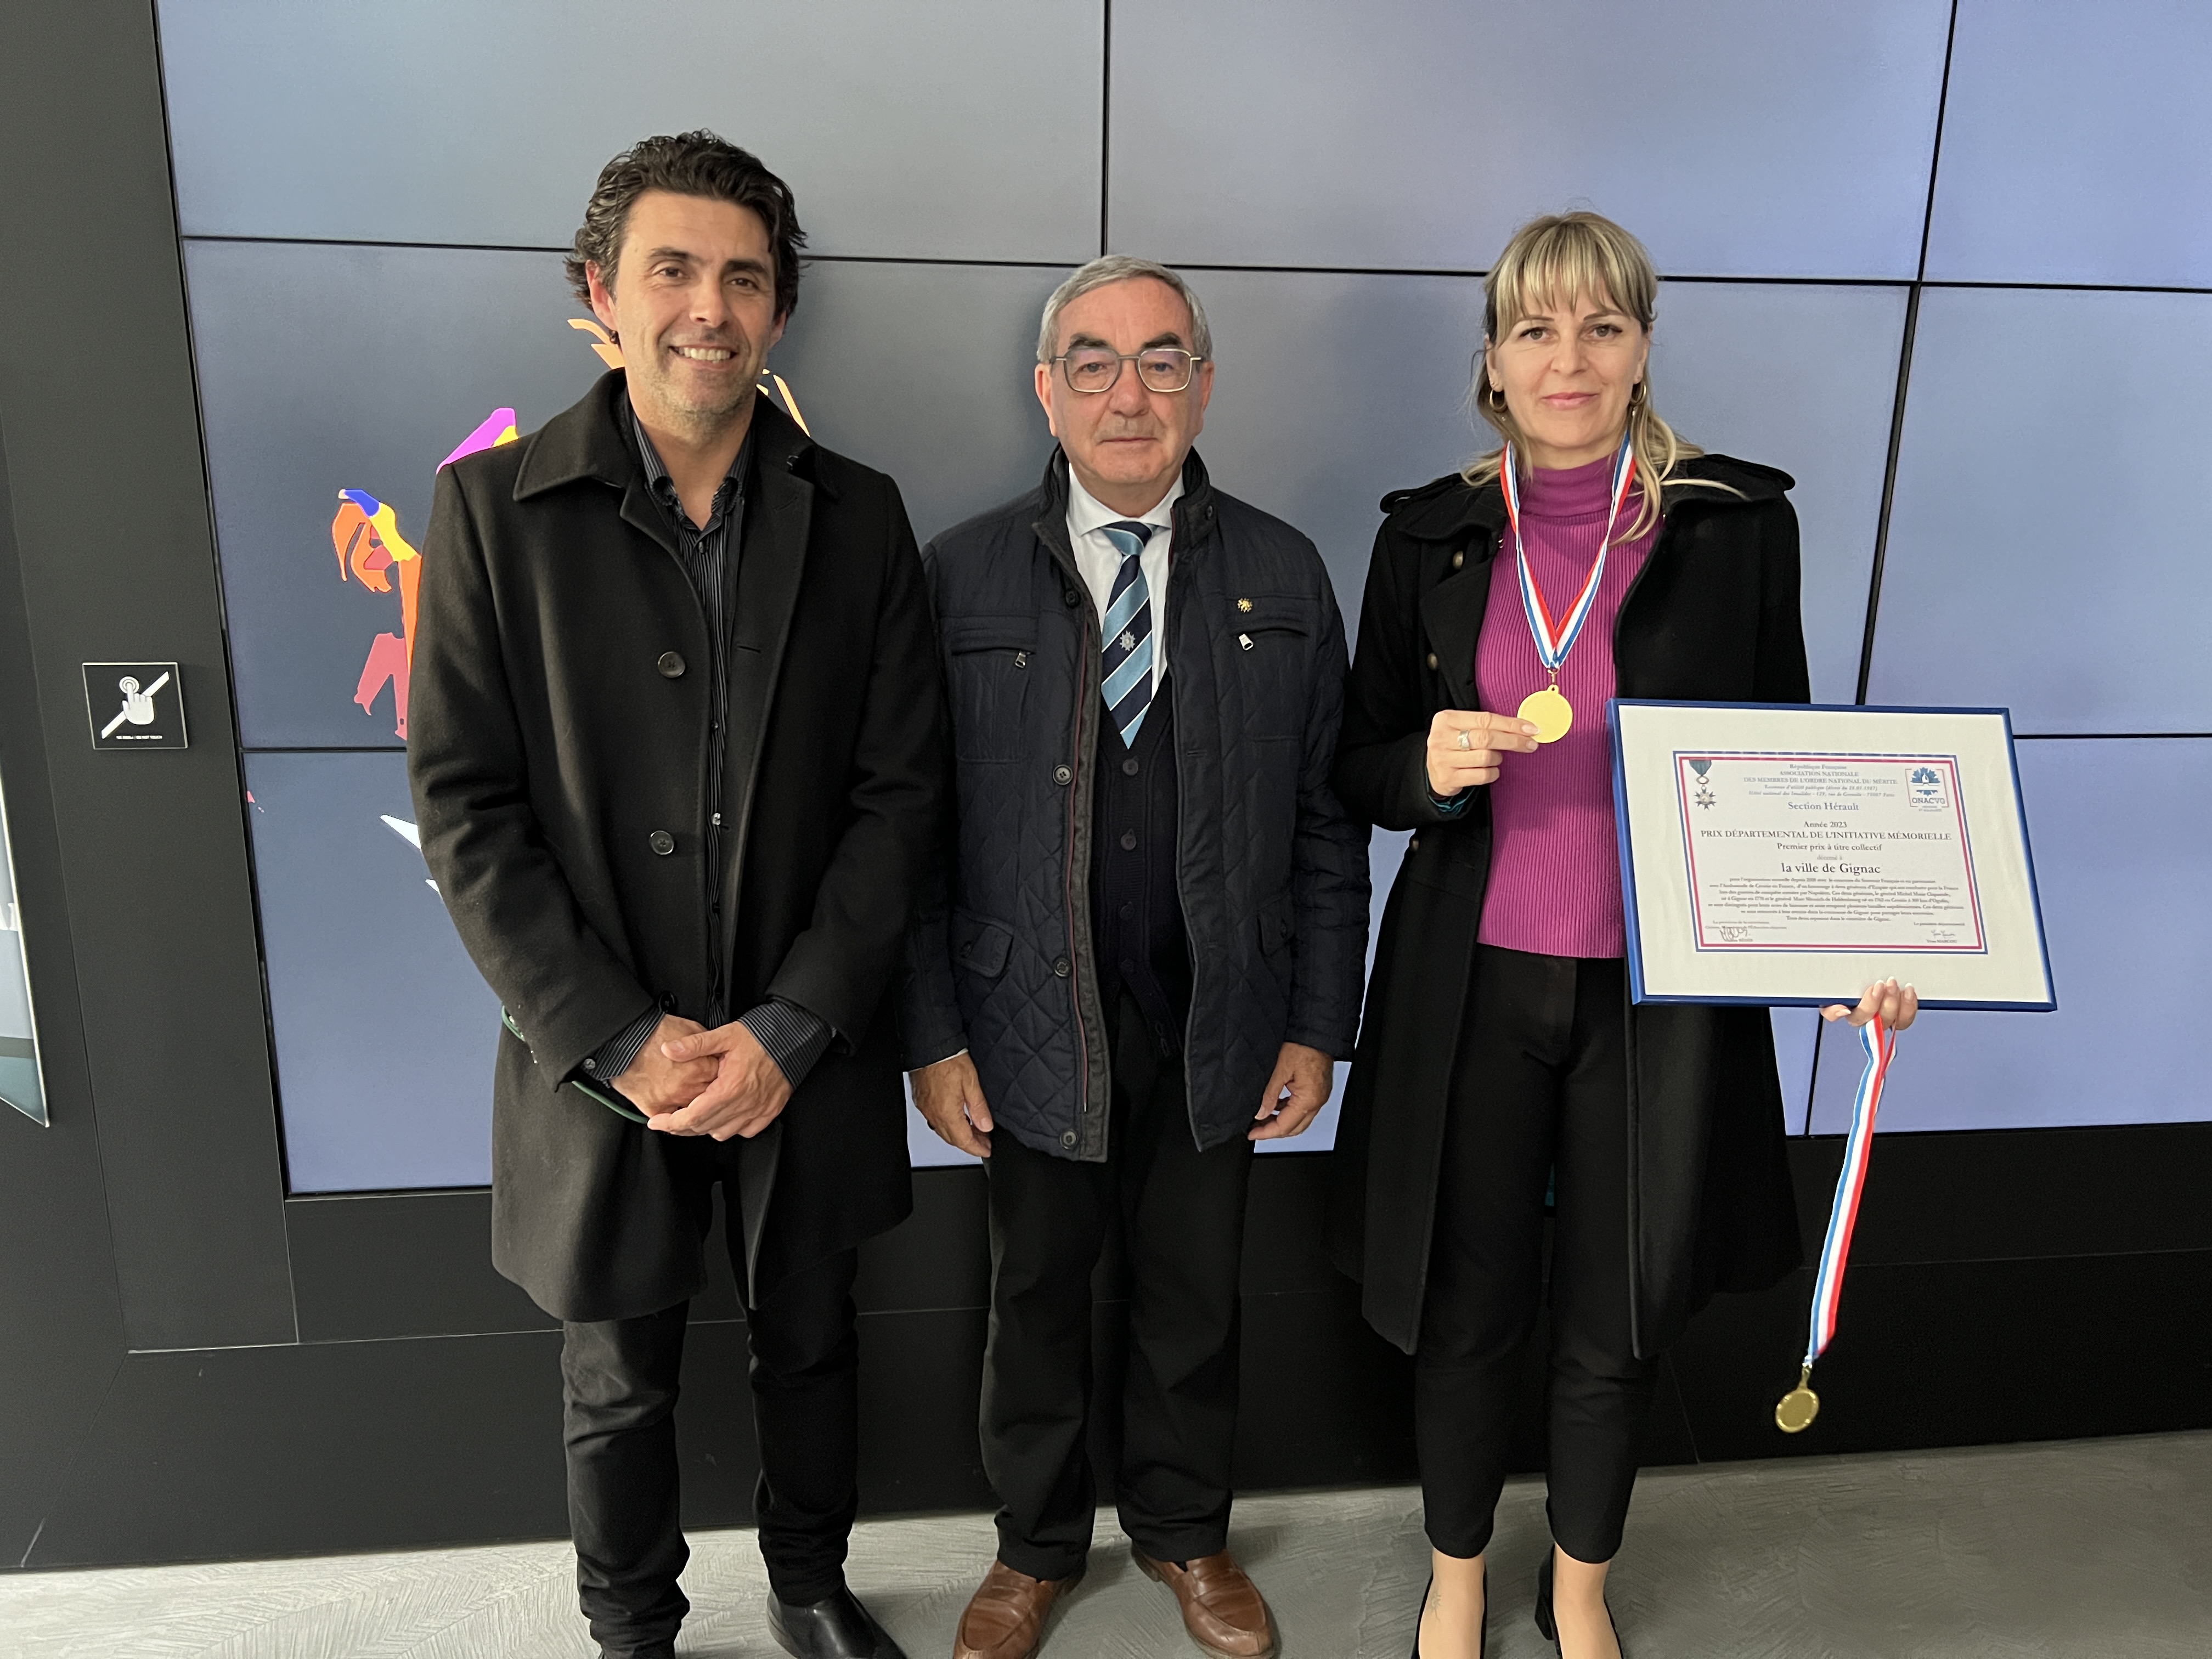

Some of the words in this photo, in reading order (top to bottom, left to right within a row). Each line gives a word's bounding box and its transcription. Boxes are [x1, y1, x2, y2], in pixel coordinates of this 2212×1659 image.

[1788, 802, 1822, 810] Section
[1824, 802, 1859, 811] Hérault
[1725, 829, 1809, 838] DÉPARTEMENTAL
[1888, 831, 1952, 840] MÉMORIELLE
[1810, 843, 1825, 851] prix
[1781, 862, 1792, 872] la
[1795, 862, 1819, 872] ville
[1822, 863, 1836, 873] de
[1839, 863, 1881, 876] Gignac
